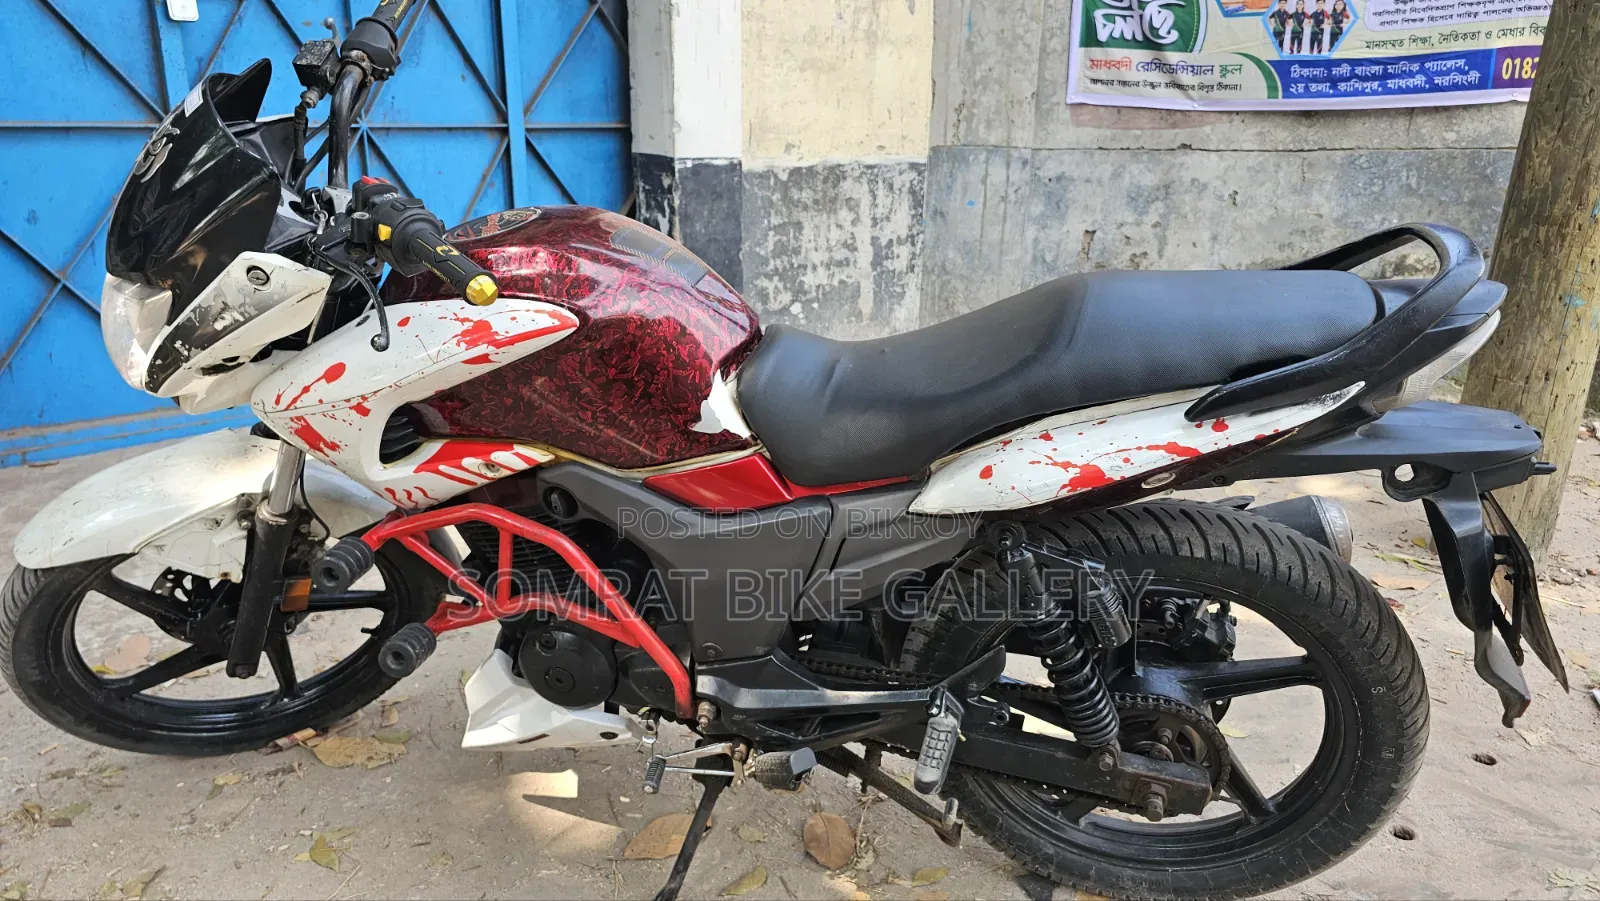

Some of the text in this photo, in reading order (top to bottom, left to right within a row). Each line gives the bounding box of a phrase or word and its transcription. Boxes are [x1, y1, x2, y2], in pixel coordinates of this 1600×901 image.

[1484, 30, 1493, 40] ও
[1496, 26, 1526, 39] মেধার
[1088, 56, 1132, 71] মাধবদী
[1331, 63, 1352, 77] নদী
[1354, 65, 1384, 77] বাংলা
[1387, 61, 1420, 74] মানিক
[1433, 70, 1482, 87] নরসিংদী
